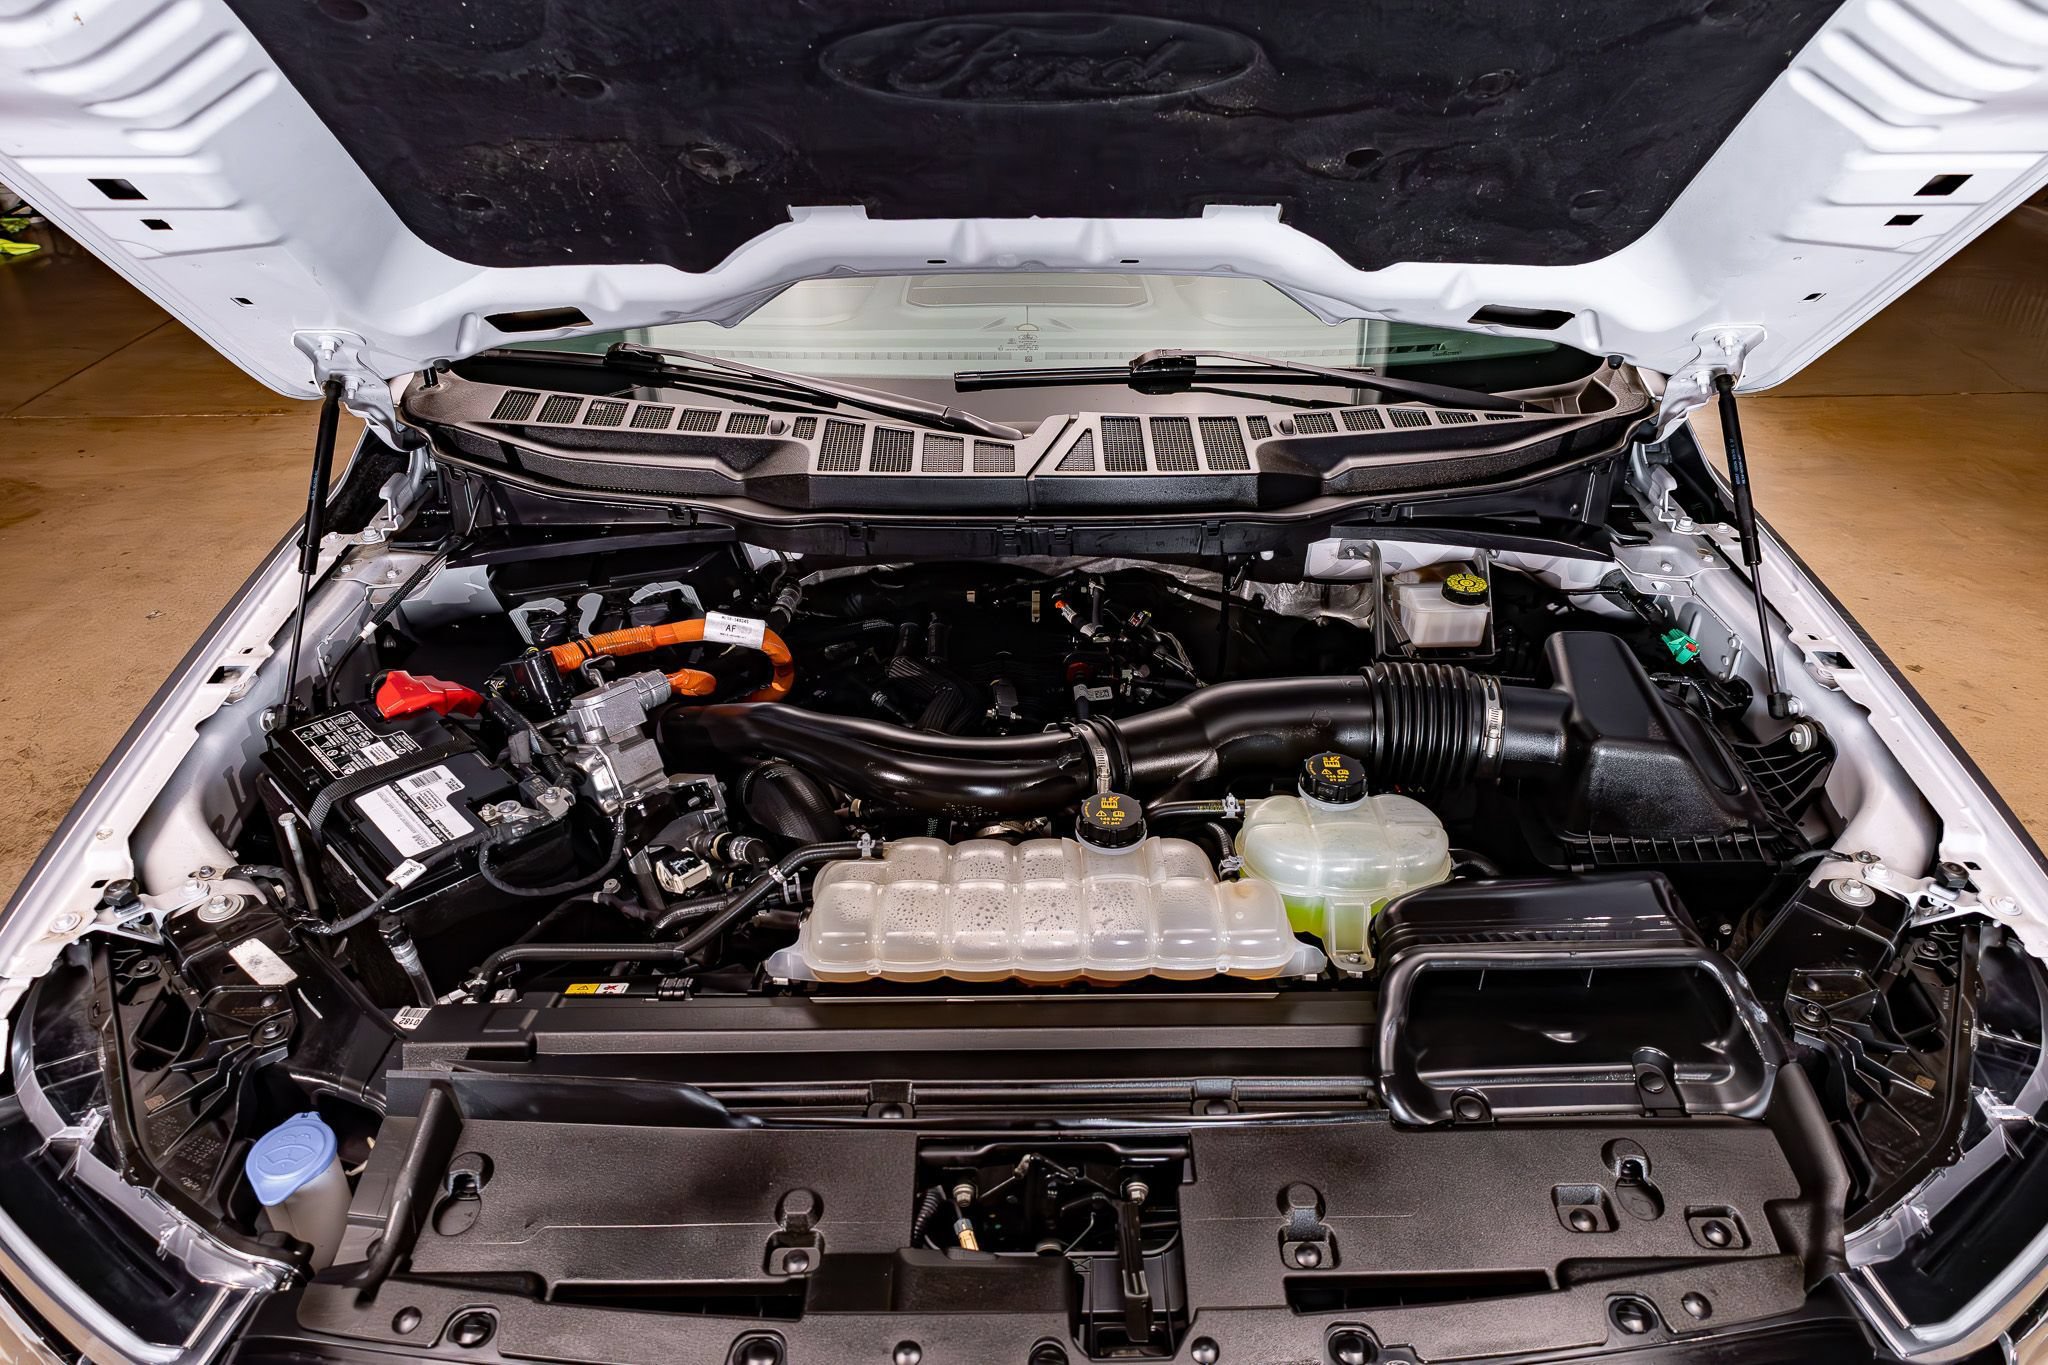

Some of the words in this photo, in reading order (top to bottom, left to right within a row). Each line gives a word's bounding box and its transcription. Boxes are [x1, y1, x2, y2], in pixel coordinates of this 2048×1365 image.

[887, 23, 1185, 97] Ford
[725, 624, 737, 632] AF
[411, 833, 430, 849] AGM
